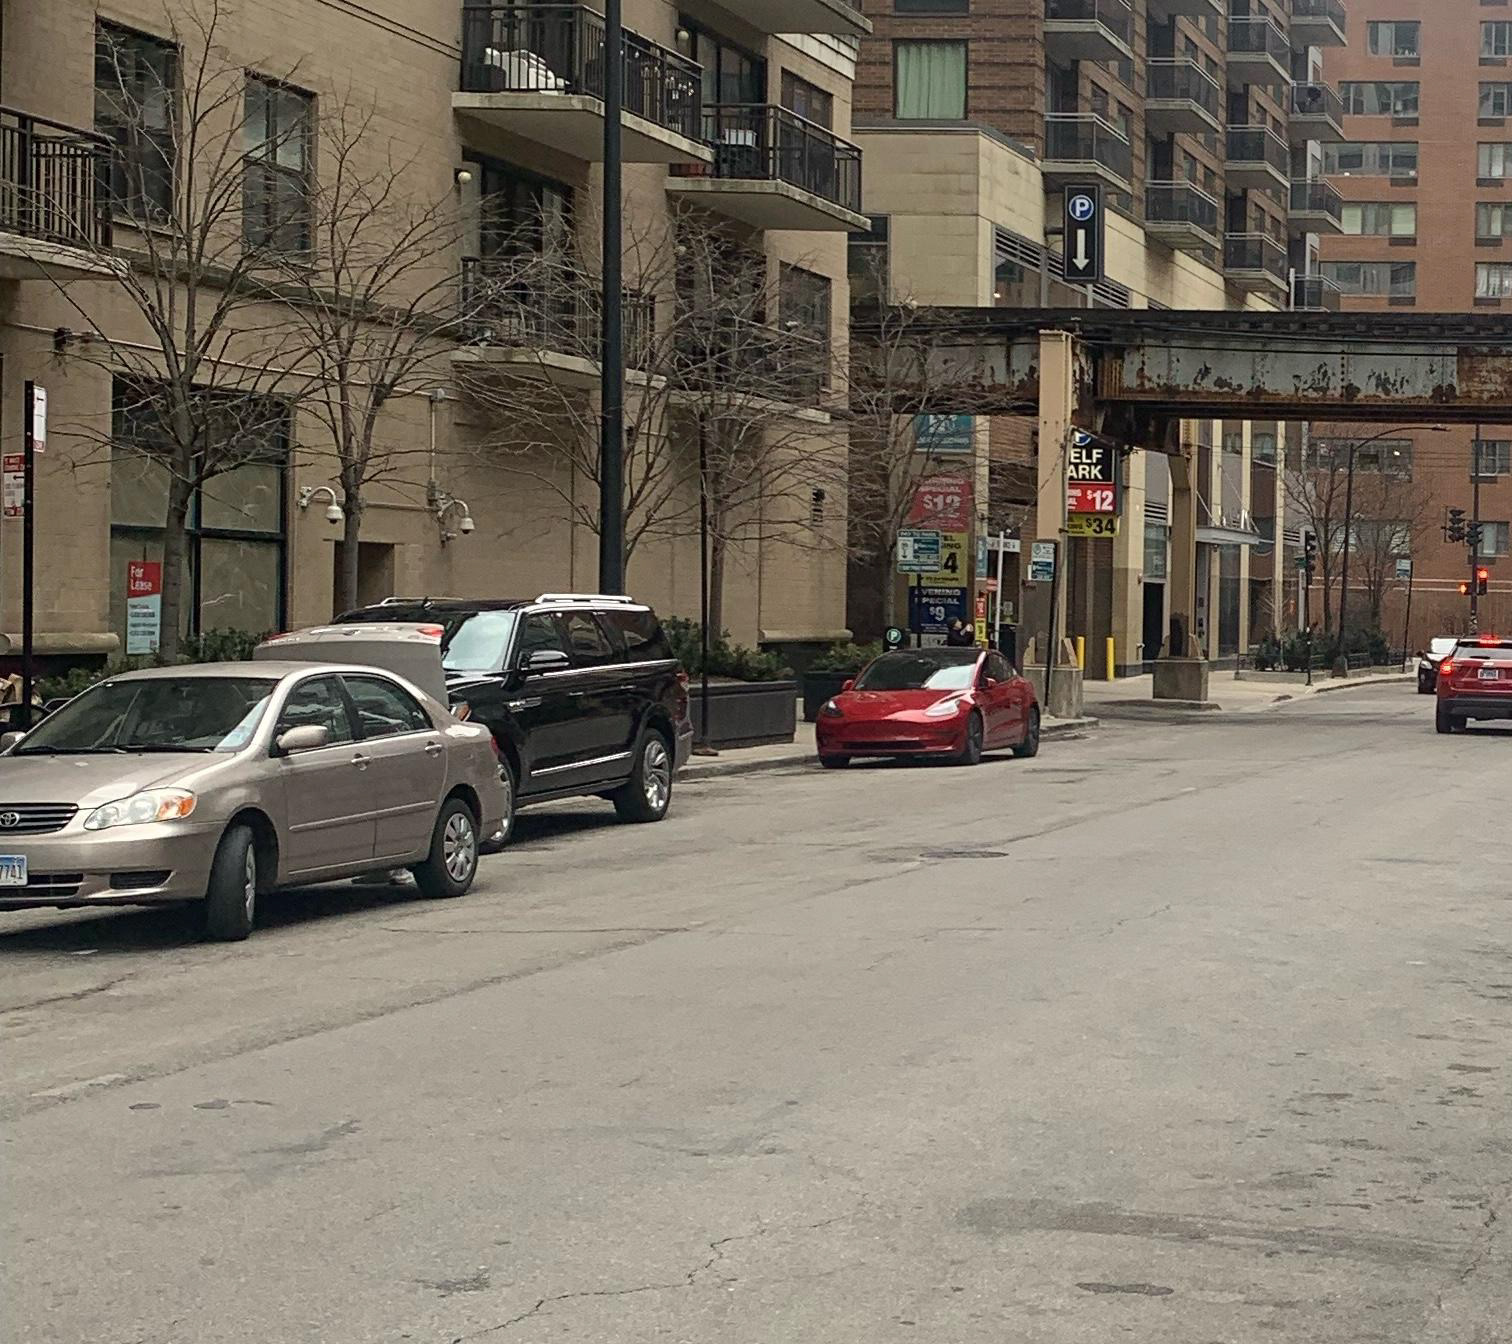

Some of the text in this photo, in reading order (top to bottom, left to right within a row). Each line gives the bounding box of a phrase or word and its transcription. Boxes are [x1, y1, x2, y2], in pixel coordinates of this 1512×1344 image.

[1075, 199, 1089, 216] P
[1069, 449, 1104, 463] ELF
[1067, 465, 1103, 479] ARK
[1086, 489, 1114, 511] $12
[1085, 517, 1116, 534] $34
[130, 565, 144, 578] For
[130, 578, 153, 592] Lease
[929, 606, 945, 621] $9
